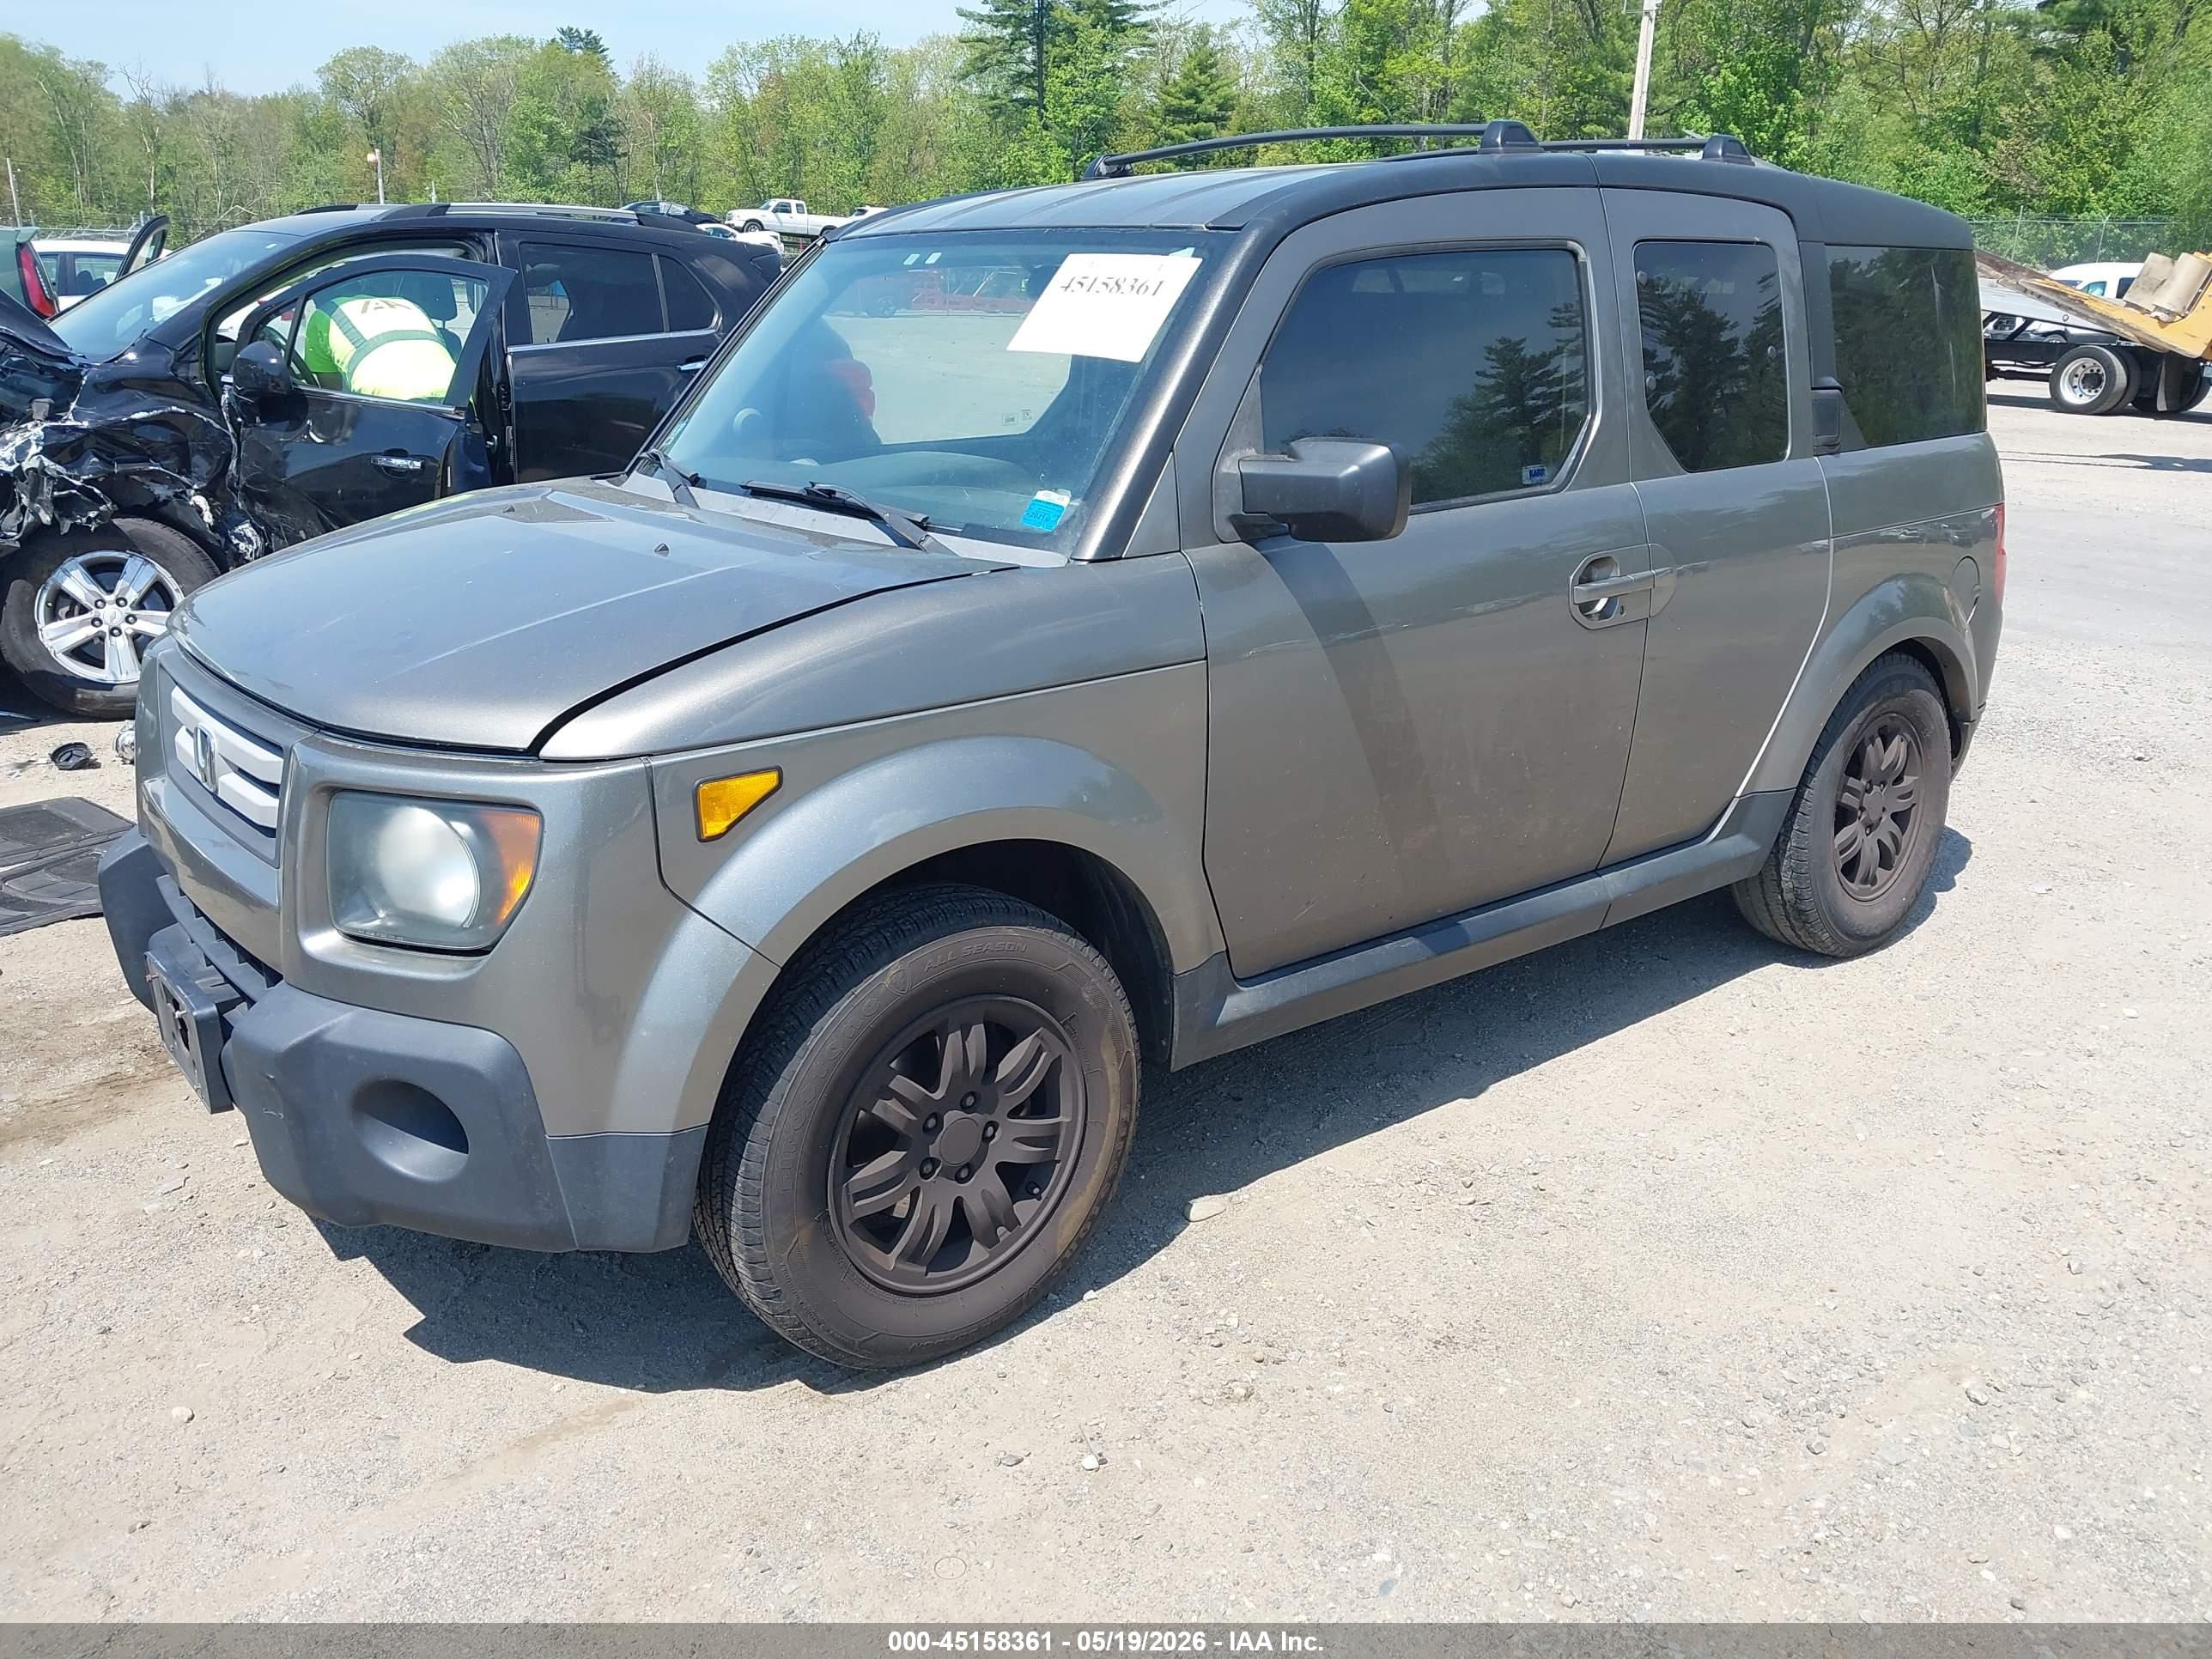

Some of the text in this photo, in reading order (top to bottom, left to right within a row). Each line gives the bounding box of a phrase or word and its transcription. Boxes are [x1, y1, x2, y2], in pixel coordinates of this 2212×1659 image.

[1060, 276, 1165, 296] 45158361
[921, 940, 1030, 975] ALL SEASON
